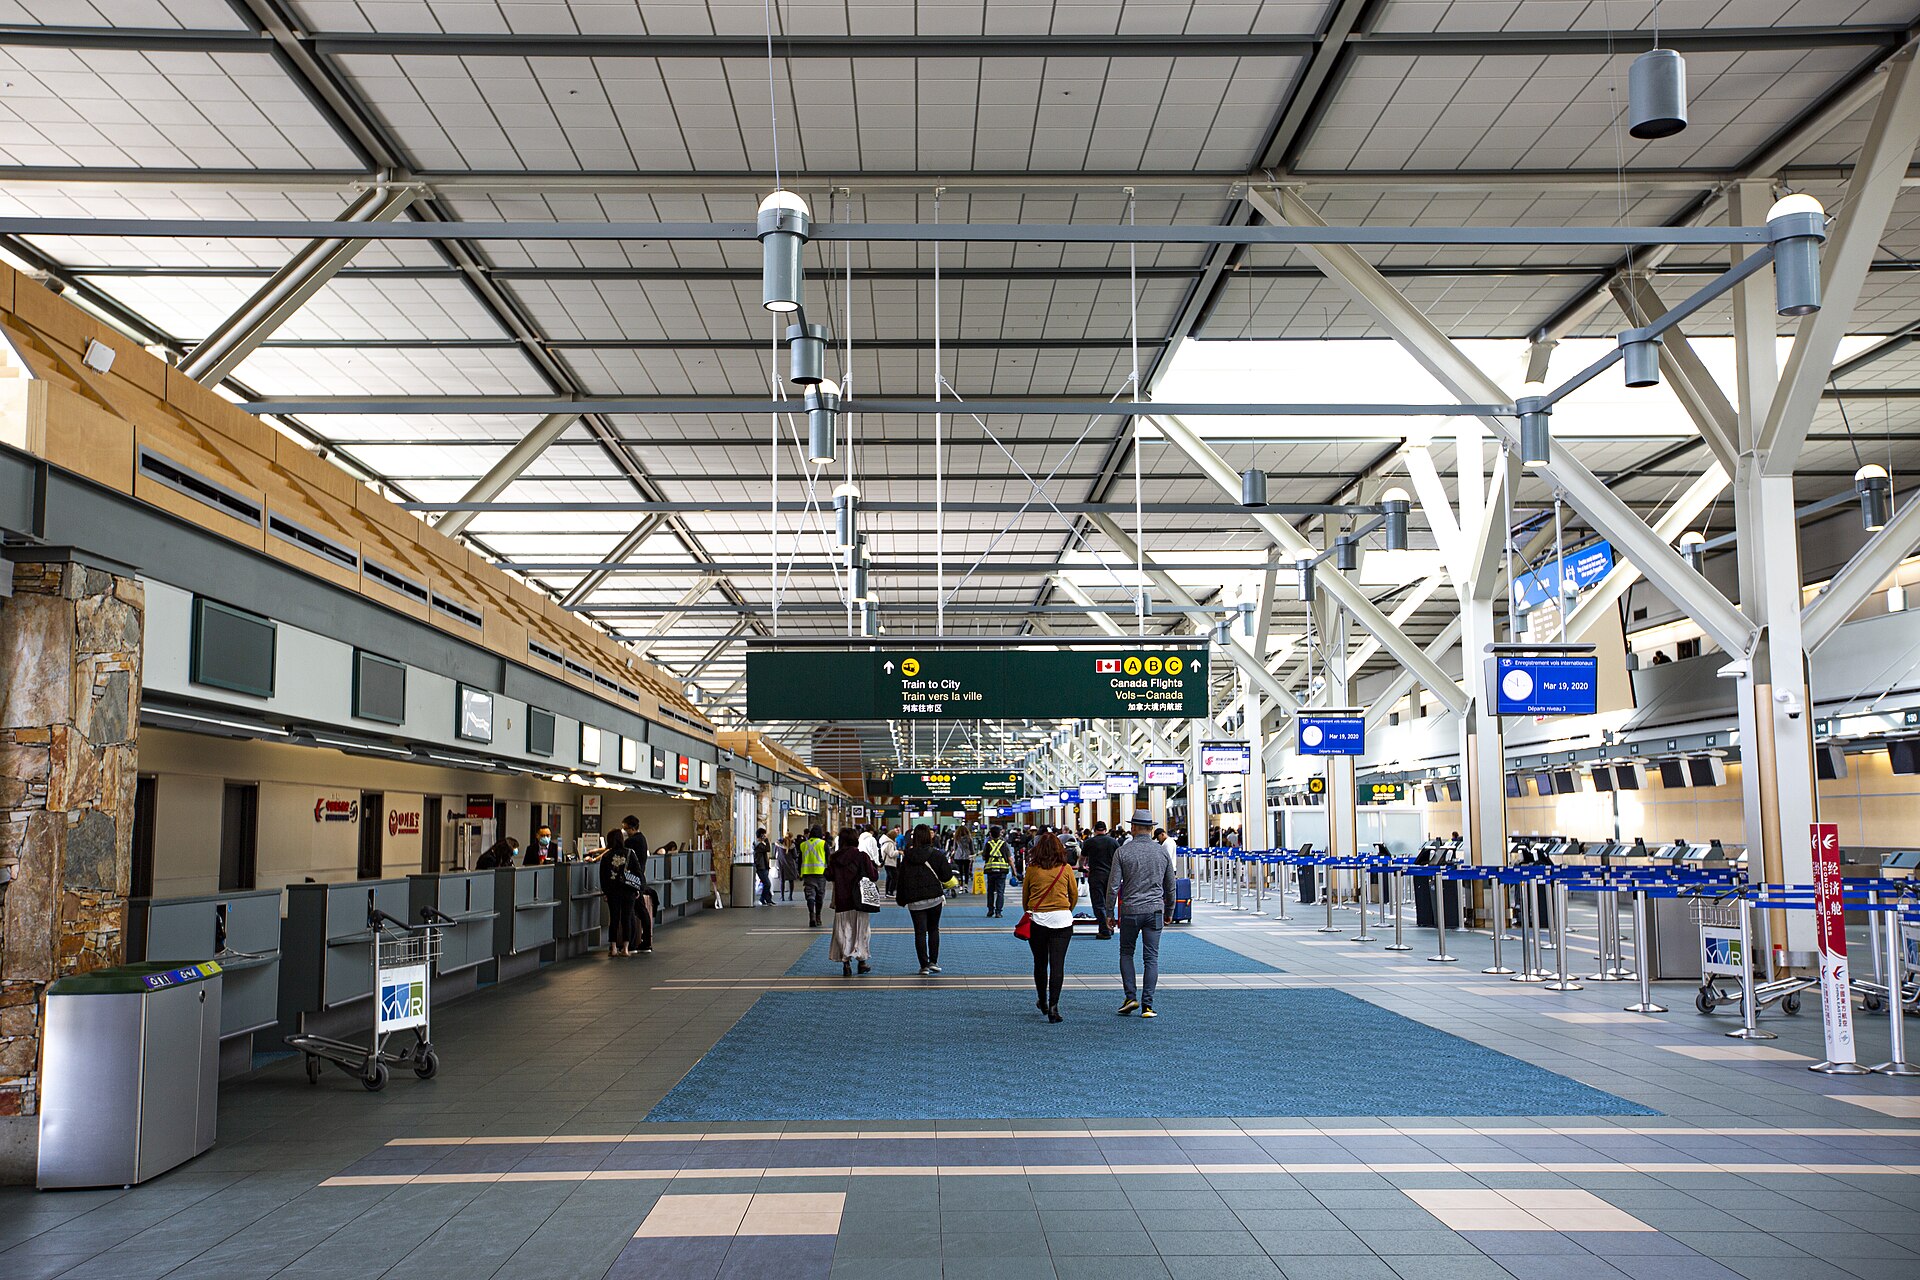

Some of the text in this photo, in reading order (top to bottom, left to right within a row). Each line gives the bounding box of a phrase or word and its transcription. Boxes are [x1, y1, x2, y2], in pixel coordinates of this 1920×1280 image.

[1128, 660, 1179, 671] A B C
[901, 679, 961, 691] Train to City
[1110, 678, 1183, 690] Canada Flights
[1543, 682, 1589, 692] Mar 19, 2020
[901, 691, 983, 701] Train vers la ville
[1827, 861, 1842, 916] 经济舱
[1706, 949, 1743, 967] YVR
[382, 997, 423, 1020] YVR
